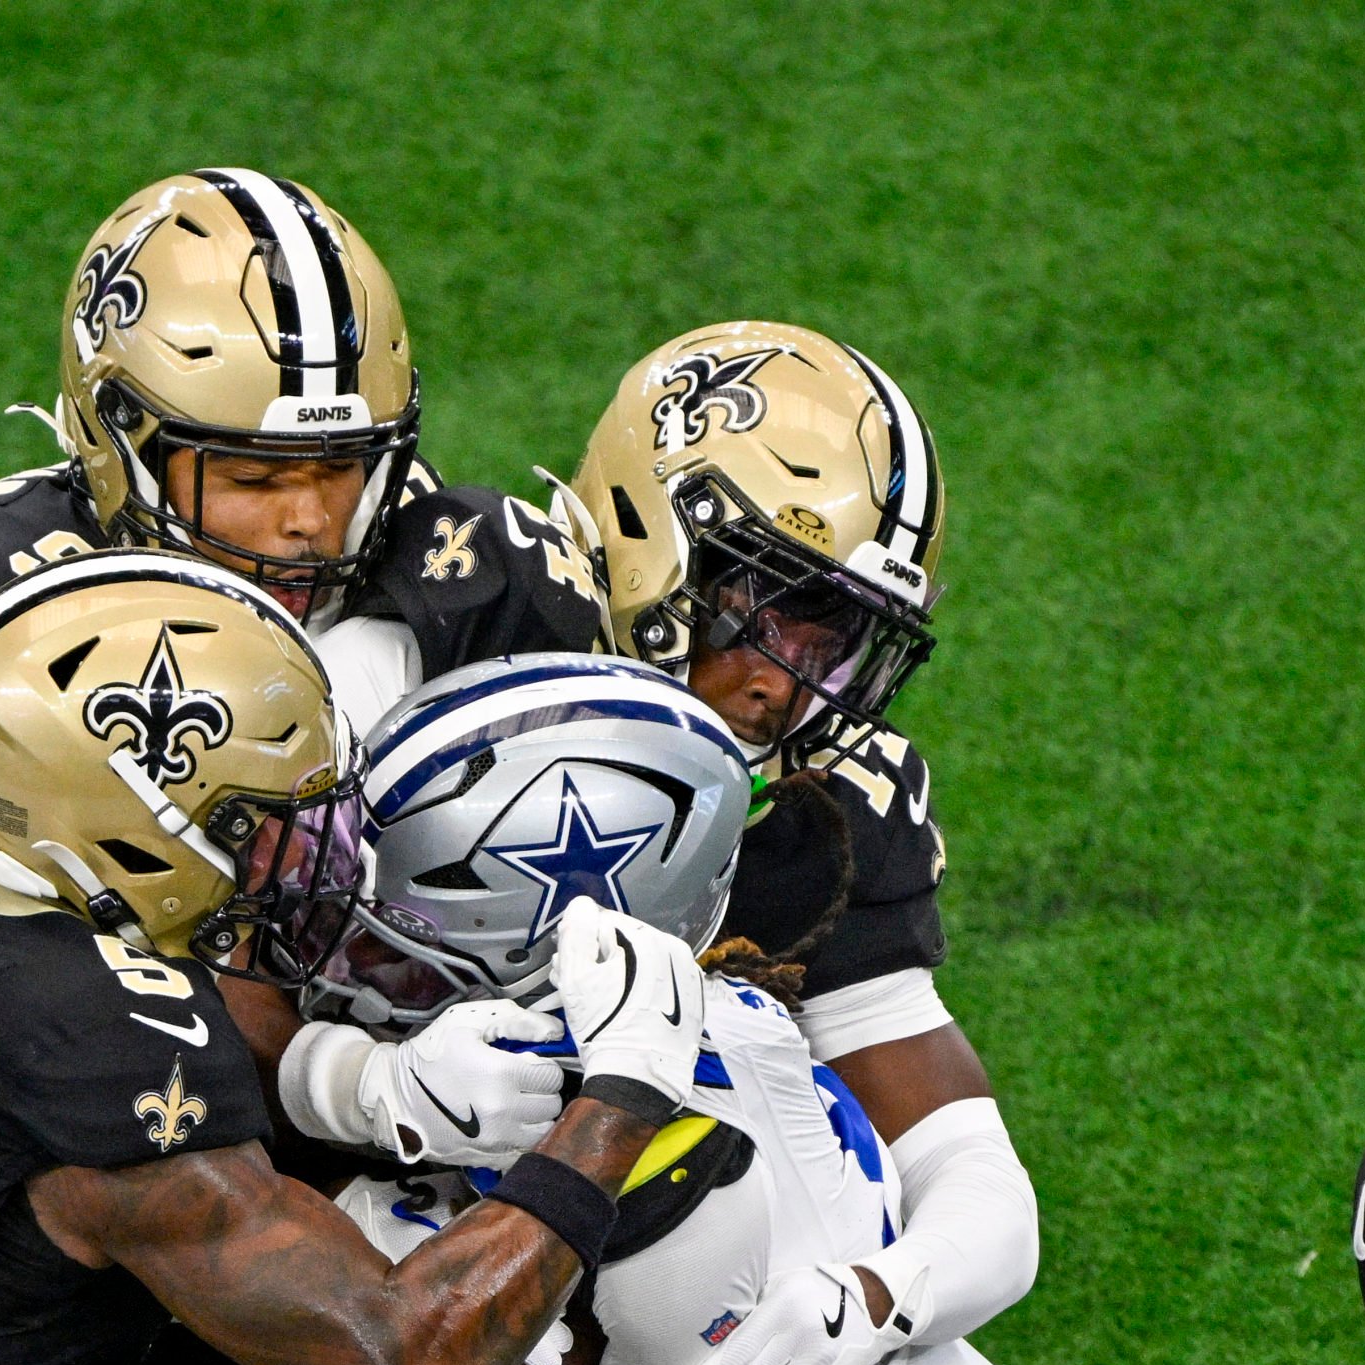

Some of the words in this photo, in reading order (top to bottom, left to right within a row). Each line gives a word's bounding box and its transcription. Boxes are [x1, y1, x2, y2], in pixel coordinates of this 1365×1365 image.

[297, 406, 352, 422] SAINTS
[777, 512, 828, 544] OAKLEY
[881, 558, 923, 588] SAINTS
[92, 933, 194, 1000] 5
